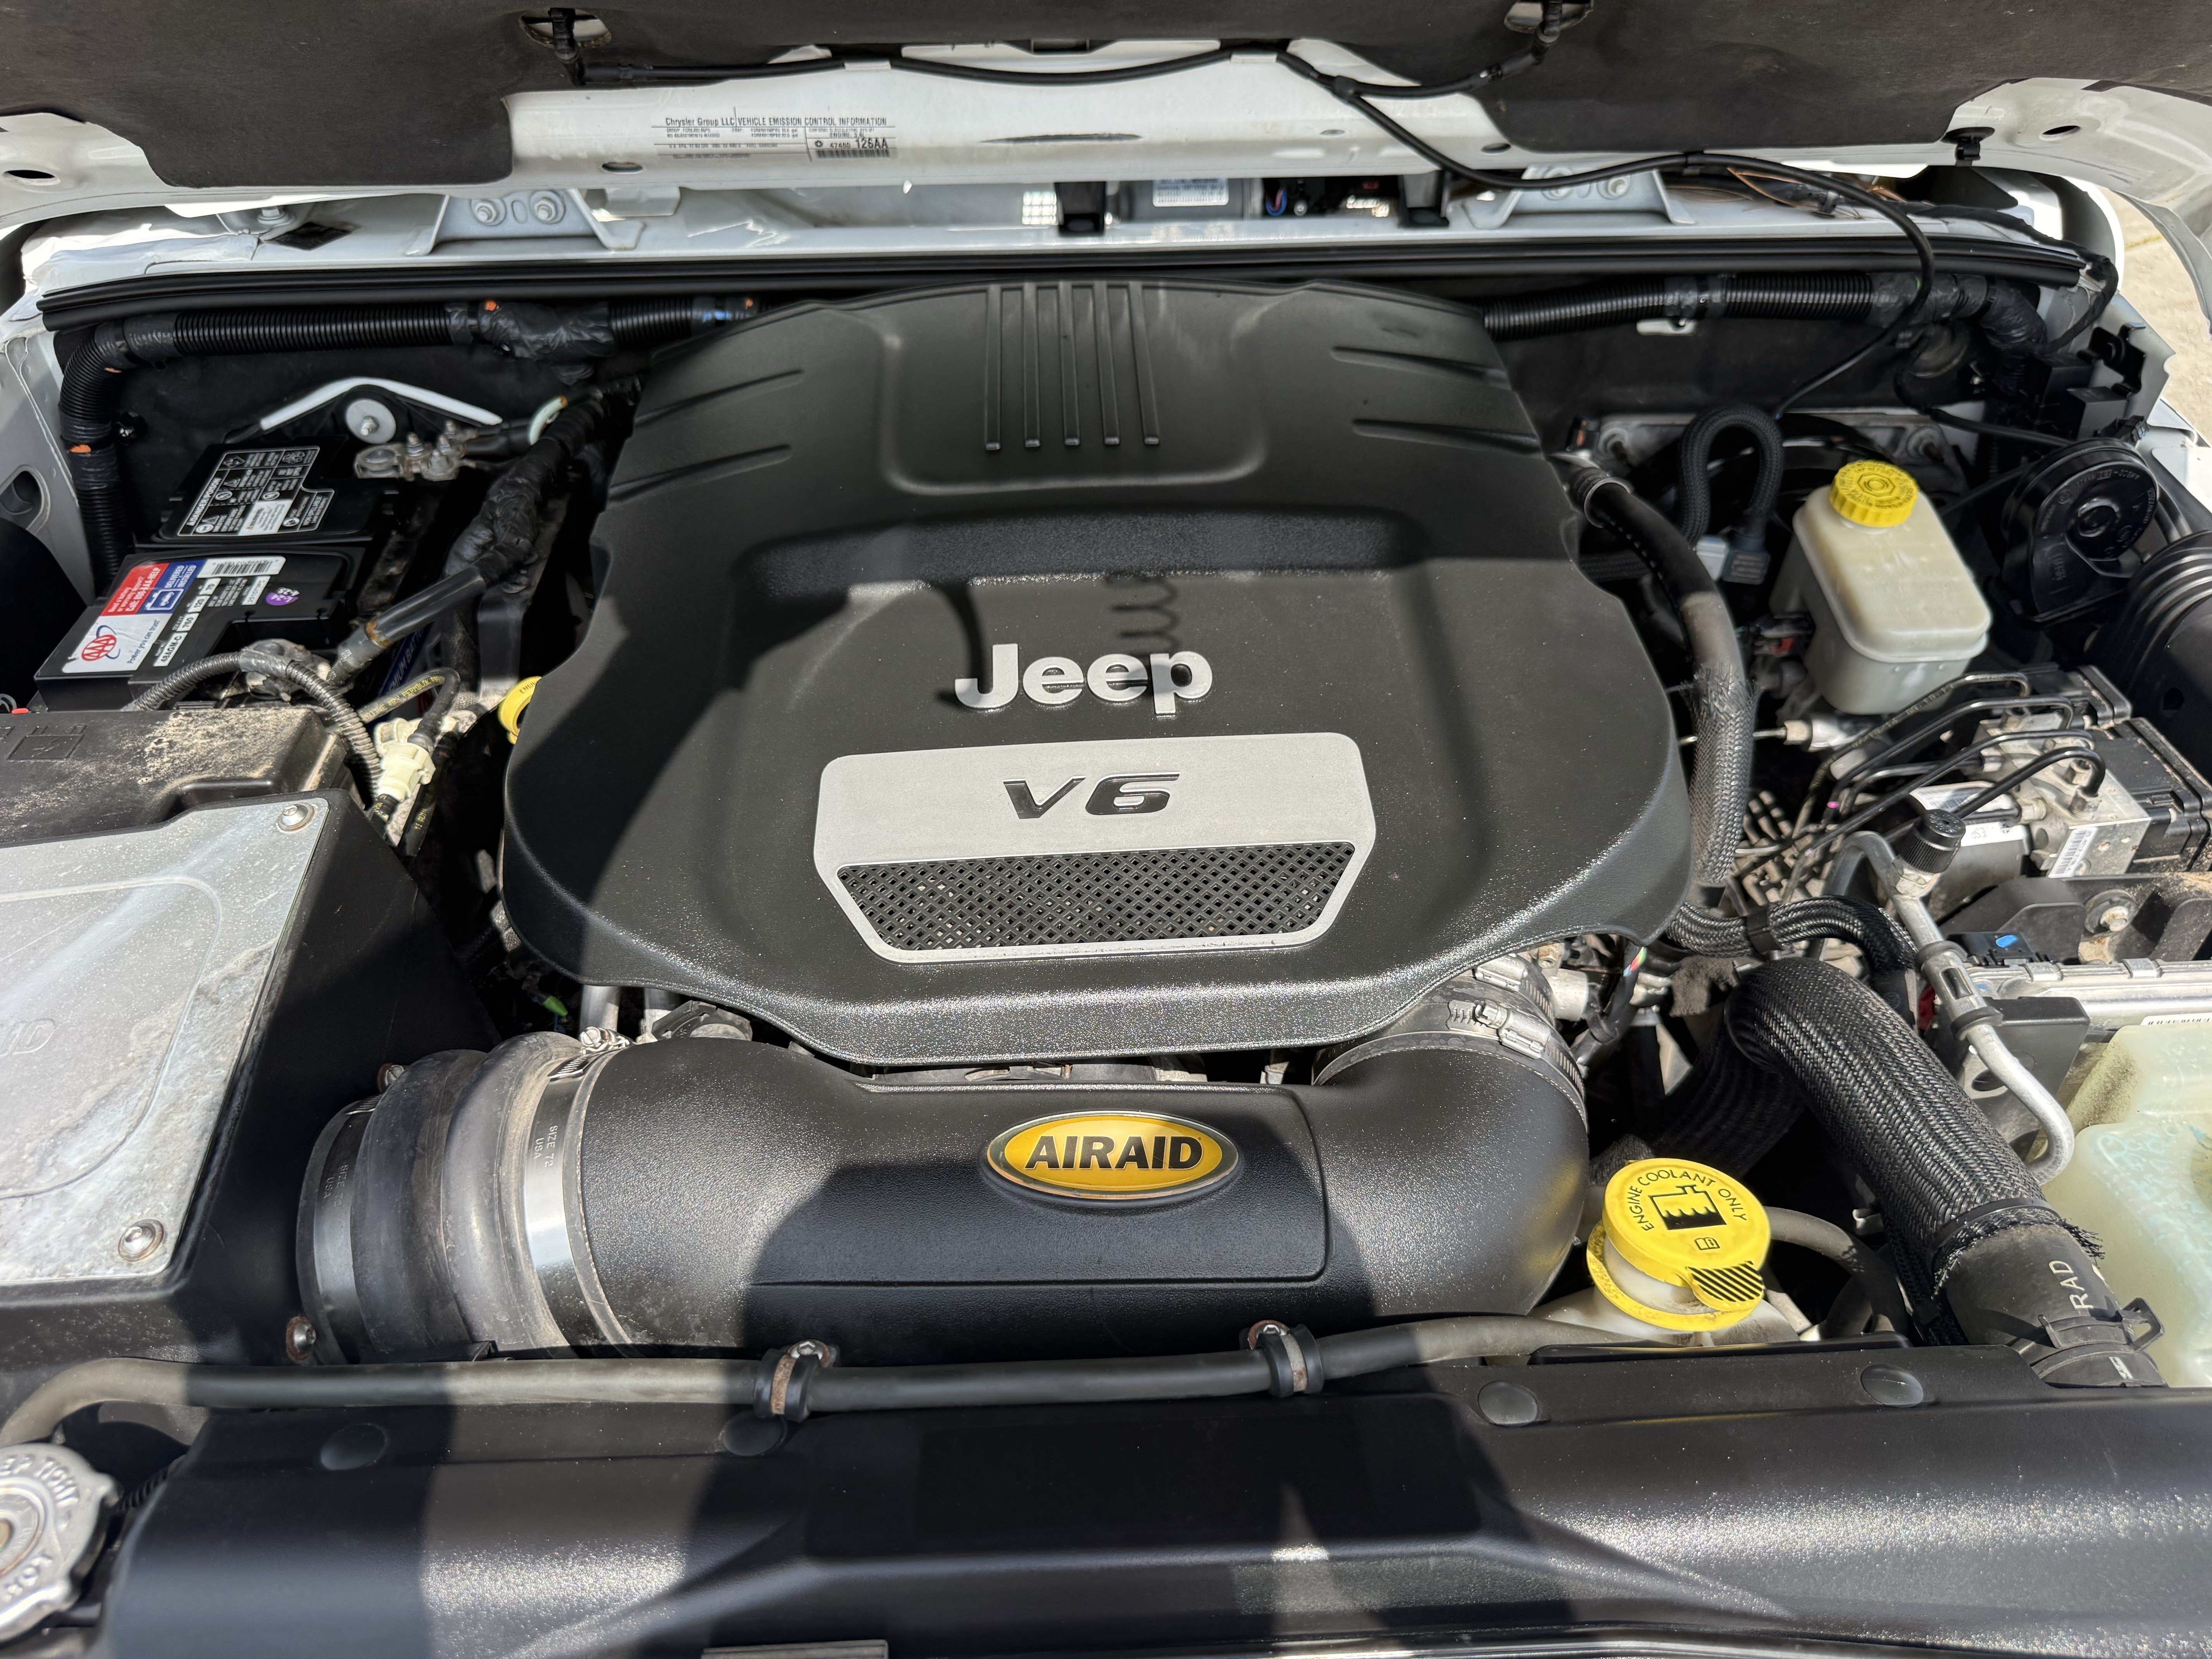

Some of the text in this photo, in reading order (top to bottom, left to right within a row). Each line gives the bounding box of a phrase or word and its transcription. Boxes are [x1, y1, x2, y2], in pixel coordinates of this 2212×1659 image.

[666, 117, 886, 127] Chrysler Group LLC VEHICLE EMISSION CONTROL INFORMATION
[165, 565, 184, 588] DELIVERED
[177, 565, 196, 587] INSTALLED
[194, 599, 205, 608] 120
[182, 617, 194, 628] 760
[127, 649, 141, 663] Power
[138, 641, 146, 649] you
[161, 636, 182, 662] 48AGM-C
[954, 643, 1213, 716] Jeep
[1003, 772, 1180, 819] V6
[533, 1137, 544, 1159] USA
[544, 1125, 558, 1168] SIZE 72
[1024, 1135, 1204, 1170] AIRAID
[324, 1177, 335, 1198] USA
[337, 1164, 349, 1189] SIZE
[1627, 1170, 1747, 1231] ENGINE COOLANT ONLY
[2049, 1260, 2094, 1309] RAD
